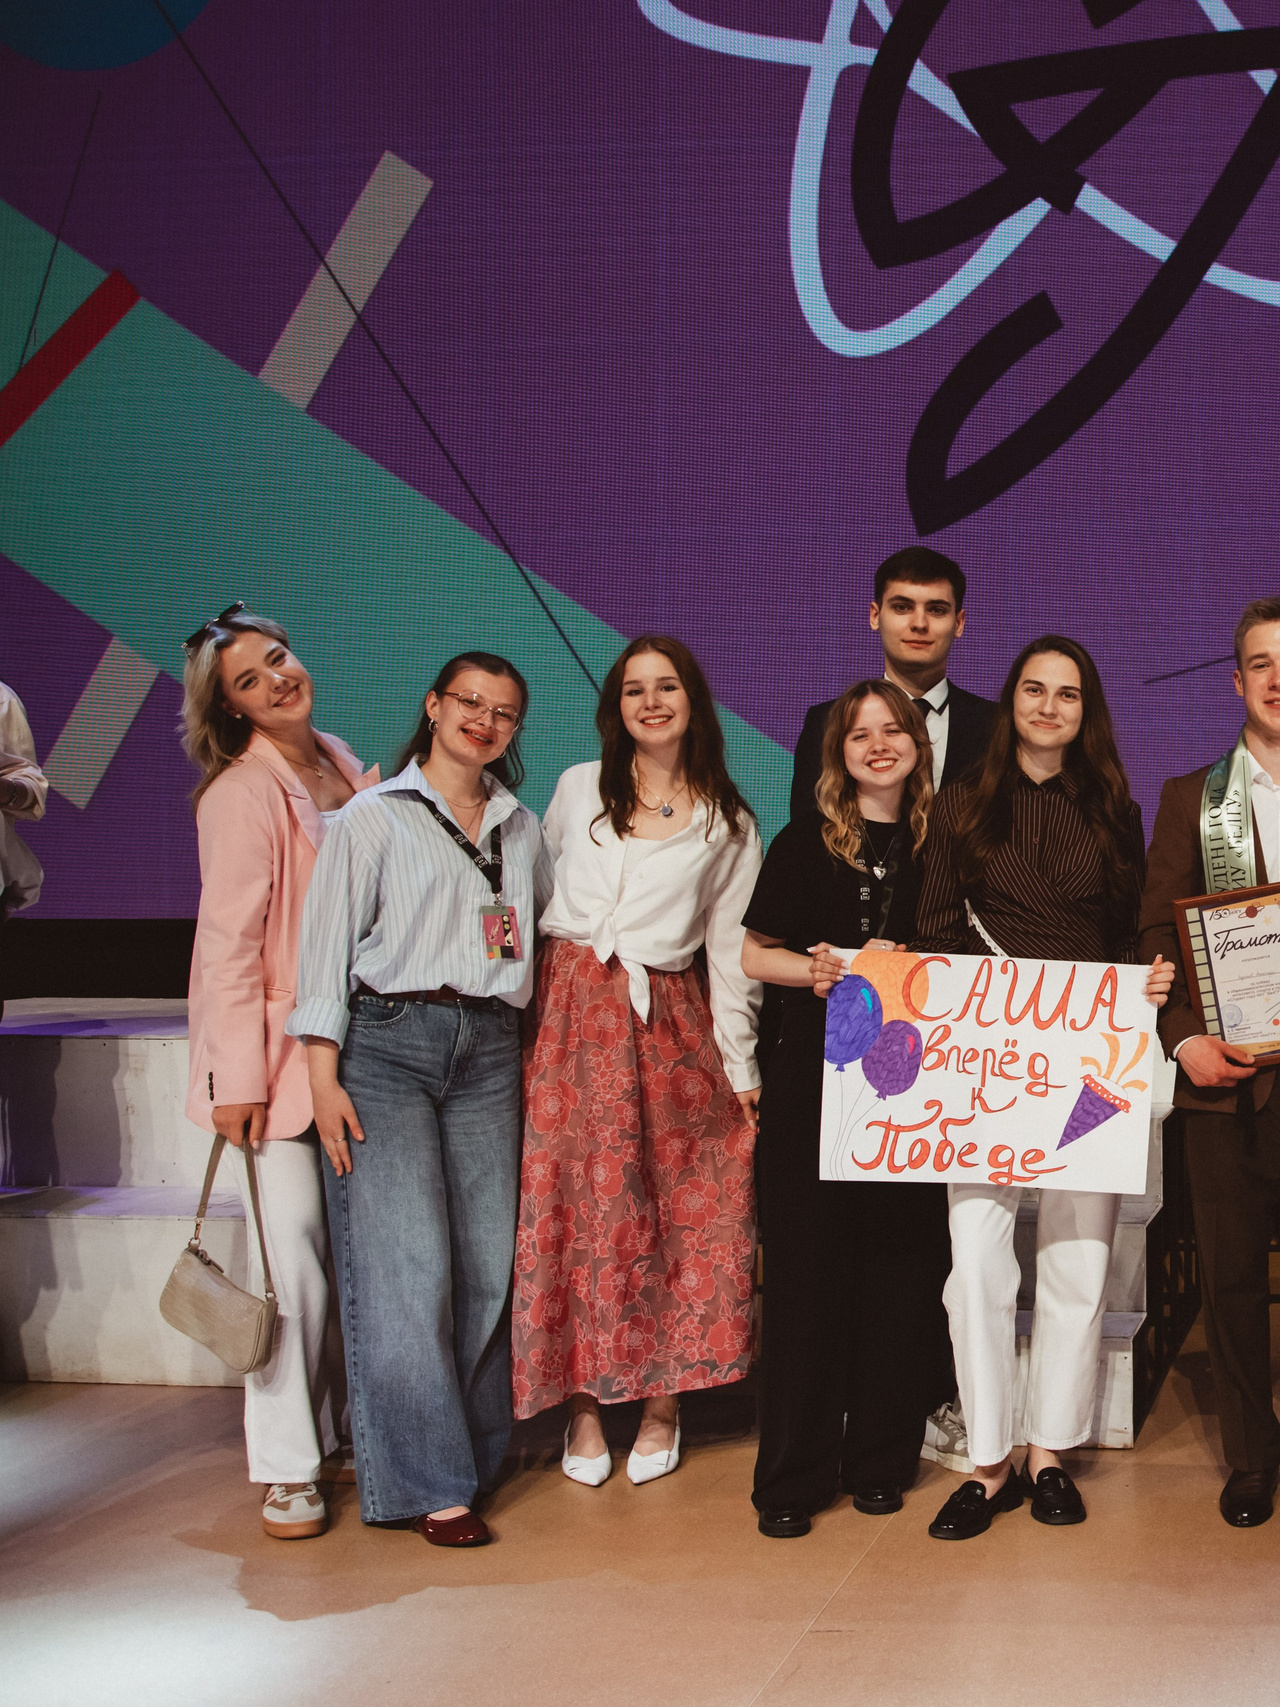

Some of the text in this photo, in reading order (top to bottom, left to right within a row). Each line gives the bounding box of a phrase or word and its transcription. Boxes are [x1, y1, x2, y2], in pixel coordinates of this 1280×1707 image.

[1230, 865, 1246, 889] ИУ
[902, 955, 1134, 1032] САША
[852, 1099, 1067, 1186] Победе
